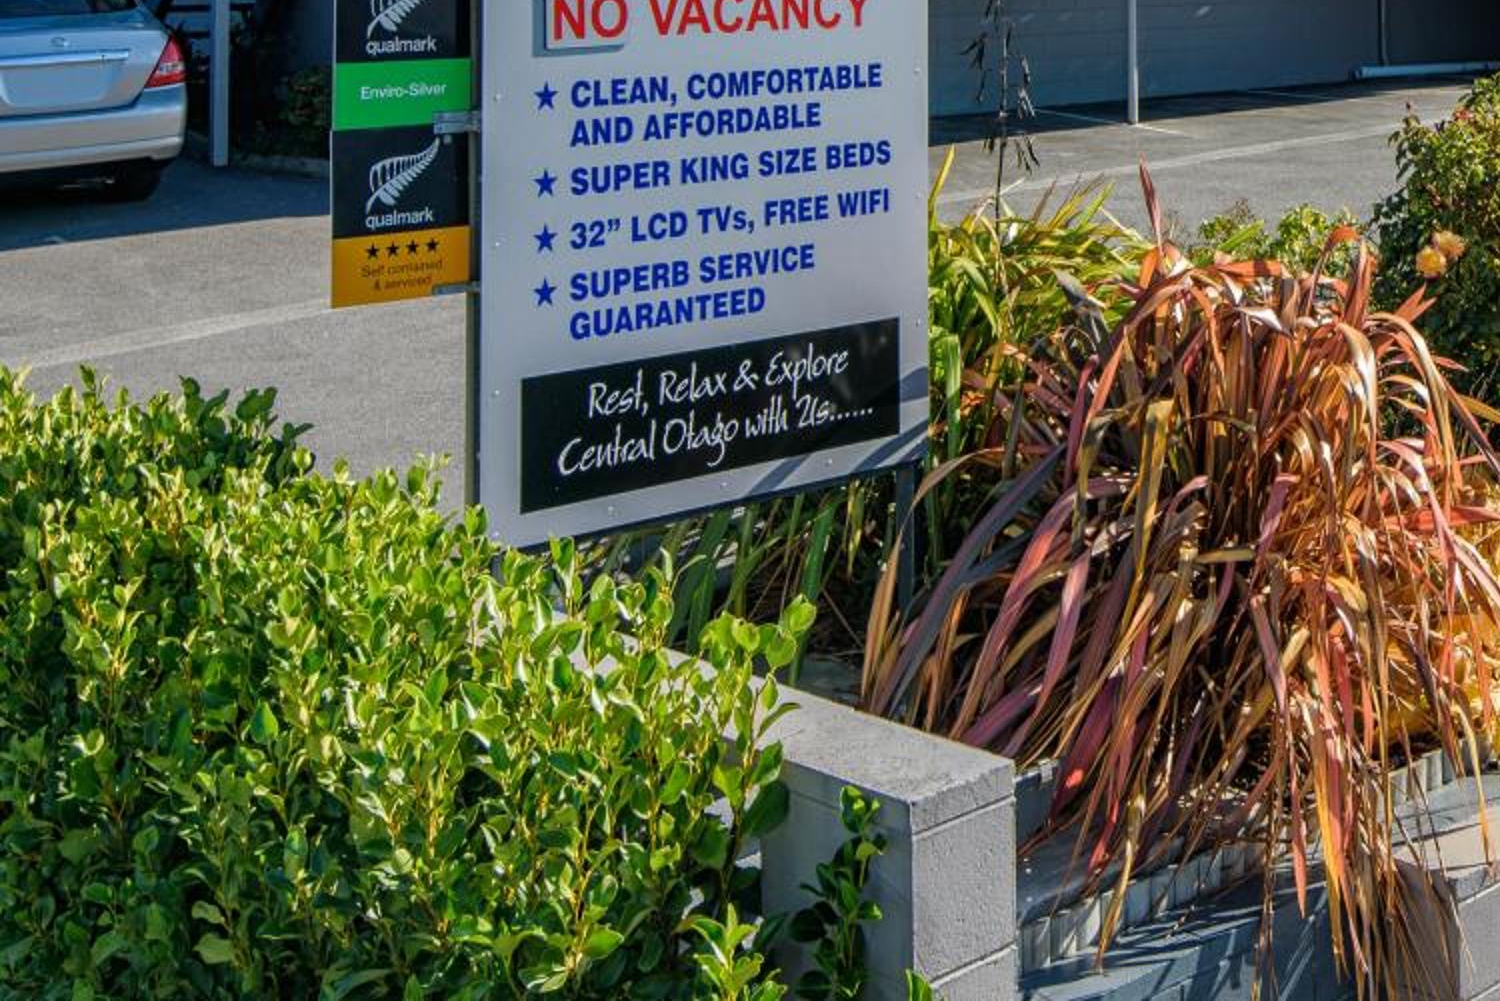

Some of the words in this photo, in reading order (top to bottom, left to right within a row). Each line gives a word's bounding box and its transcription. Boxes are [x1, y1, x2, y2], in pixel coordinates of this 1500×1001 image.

[365, 33, 438, 56] qualmark
[360, 81, 447, 101] Enviro-Silver
[571, 75, 678, 109] CLEAN,
[687, 62, 883, 100] COMFORTABLE
[570, 116, 633, 147] AND
[643, 102, 822, 142] AFFORDABLE
[571, 160, 671, 196] SUPER
[680, 152, 749, 184] KING
[758, 146, 817, 177] SIZE
[826, 140, 892, 170] BEDS
[365, 206, 434, 231] qualmark
[631, 211, 687, 242] LCD
[697, 205, 755, 234] TVs,
[764, 194, 829, 227] FREE
[838, 187, 890, 218] WIFI
[570, 260, 690, 302] SUPERB
[699, 243, 816, 284] SERVICE
[570, 287, 767, 341] GUARANTEED
[588, 368, 650, 419] Rest,
[658, 361, 728, 407] Relax
[733, 358, 759, 392] &
[765, 342, 849, 401] Explore
[557, 418, 657, 477] Central
[663, 408, 740, 468] Otago
[744, 397, 788, 439] with
